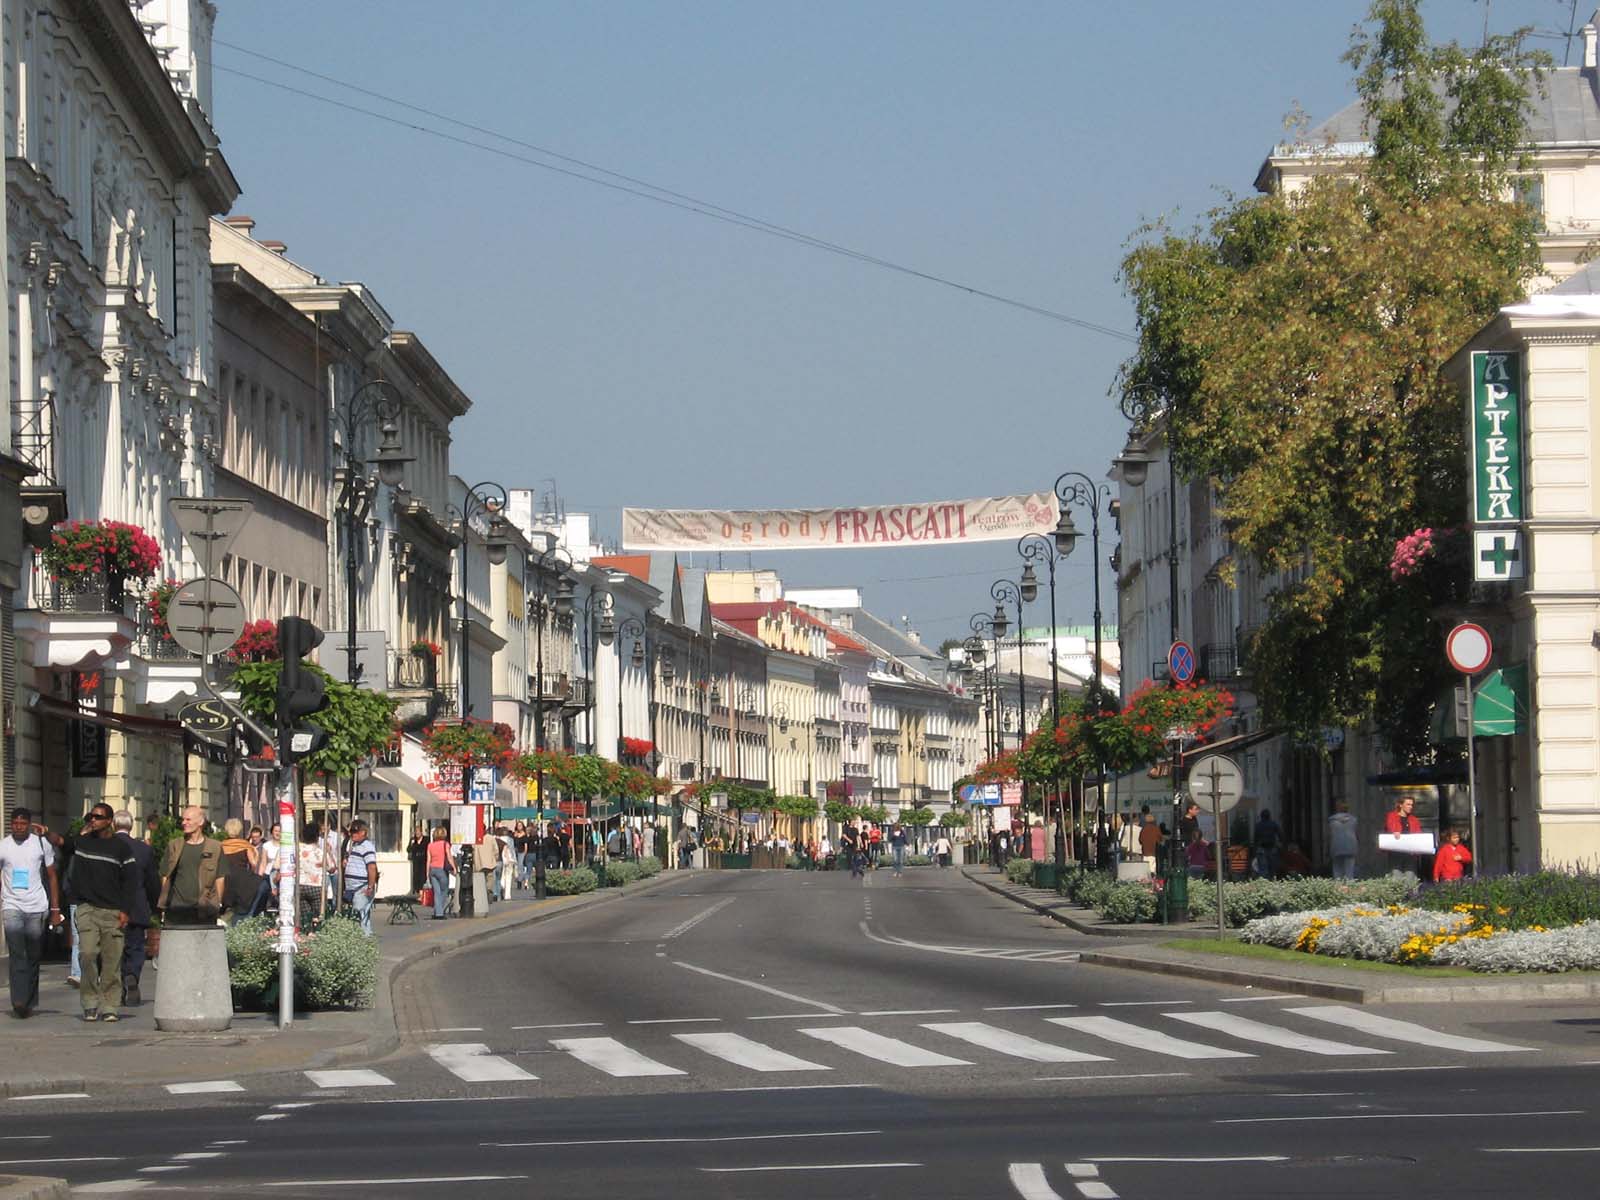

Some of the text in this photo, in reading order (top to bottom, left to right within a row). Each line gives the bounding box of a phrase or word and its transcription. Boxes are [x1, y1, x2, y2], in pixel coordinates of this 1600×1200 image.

[1483, 356, 1513, 518] APTEKA
[721, 513, 830, 542] ogrody
[833, 503, 967, 544] FRASCATI
